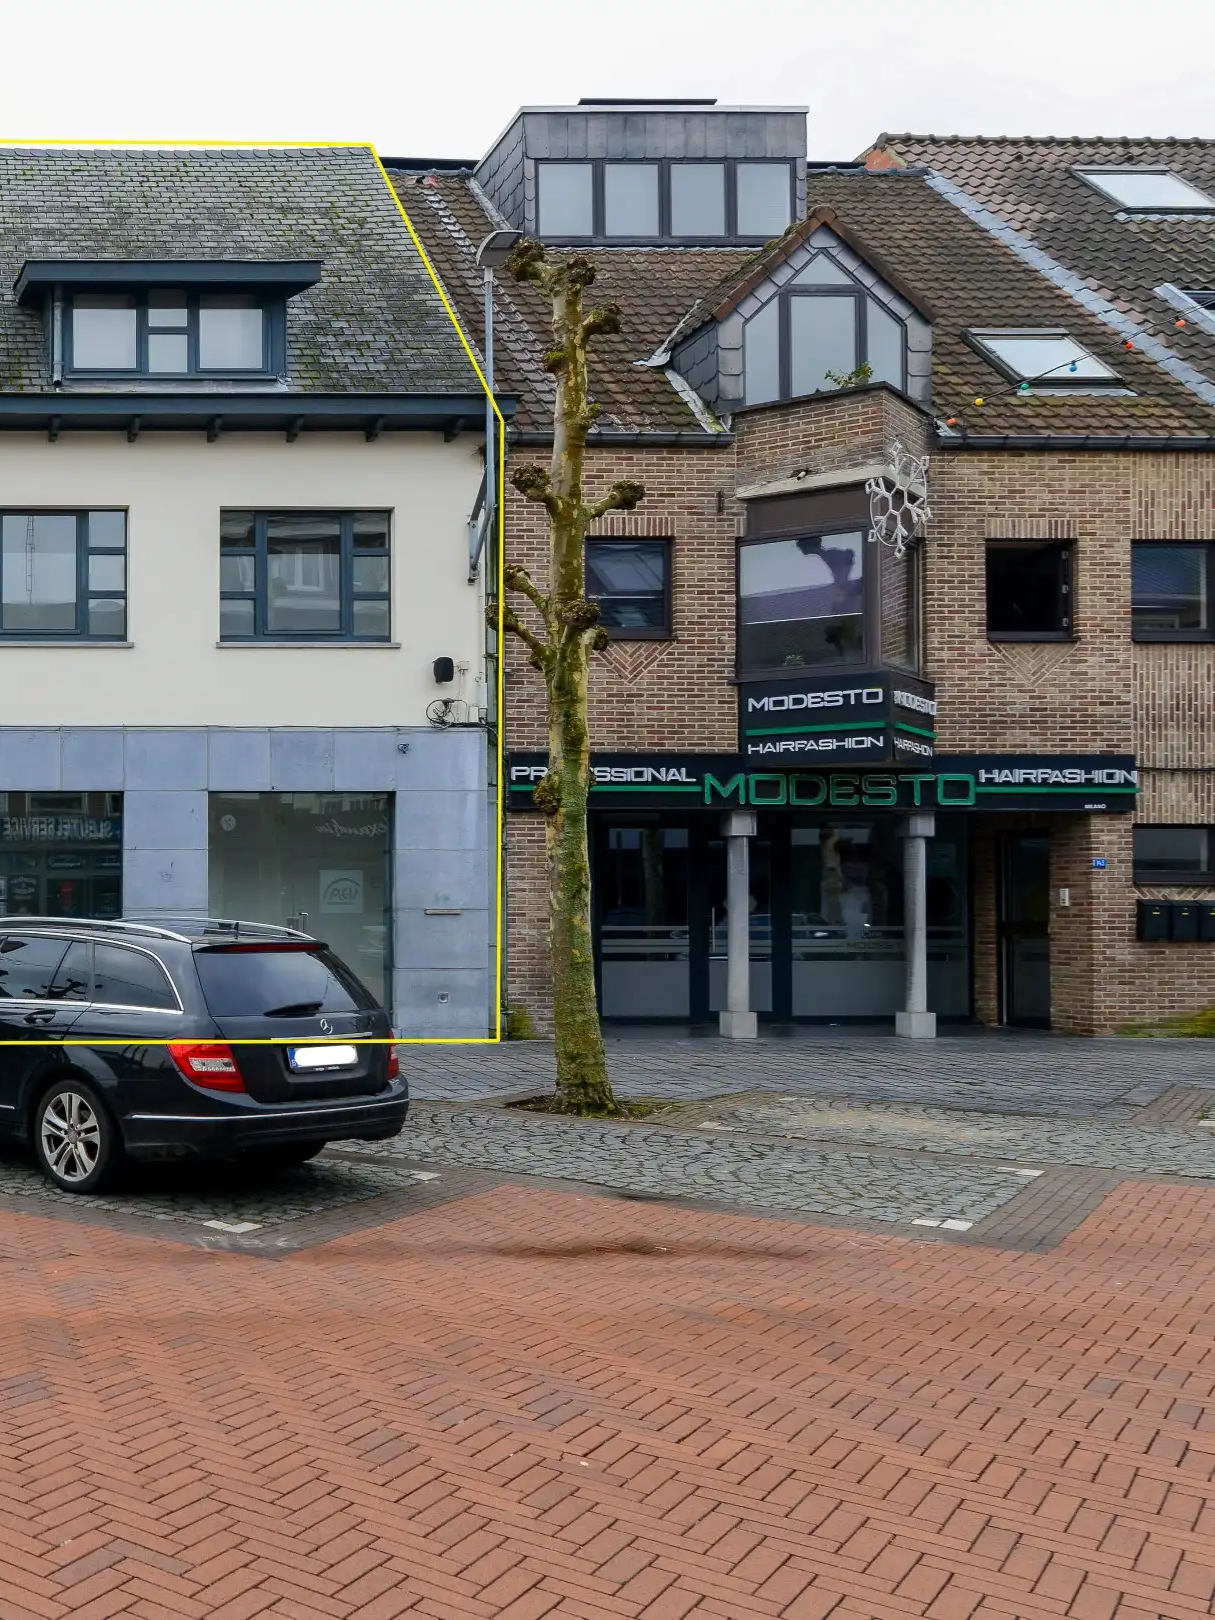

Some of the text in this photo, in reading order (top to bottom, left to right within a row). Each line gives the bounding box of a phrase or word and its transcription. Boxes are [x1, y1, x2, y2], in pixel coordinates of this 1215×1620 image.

[748, 688, 883, 712] MODESTO
[748, 736, 884, 755] HAIRFASHION
[893, 737, 933, 757] HAIRFASHION
[510, 766, 697, 782] PRSSIONAL
[979, 769, 1138, 784] HAIRFASHION
[703, 772, 976, 806] MODESTO
[846, 941, 902, 950] MODEST
